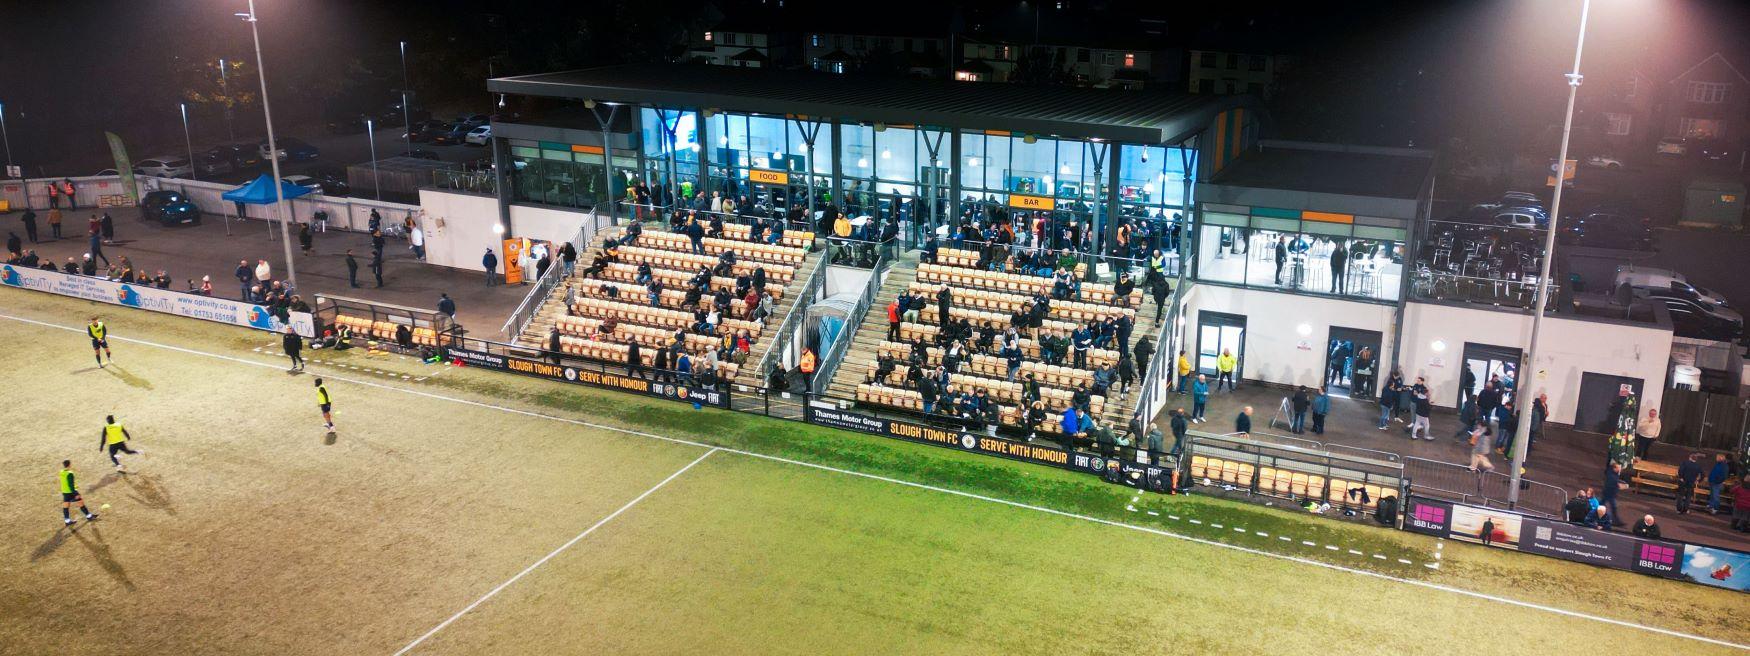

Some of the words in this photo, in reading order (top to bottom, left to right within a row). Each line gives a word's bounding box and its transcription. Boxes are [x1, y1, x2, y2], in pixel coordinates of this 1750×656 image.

[1024, 198, 1039, 206] BAR
[177, 297, 237, 311] www.optivity.co.uk
[194, 309, 213, 318] 01753
[469, 352, 485, 360] Motor
[485, 355, 502, 364] Group
[508, 359, 533, 372] SLOUGH
[534, 363, 552, 375] TOWN
[553, 367, 562, 377] FC
[579, 371, 600, 384] SERVE
[601, 374, 618, 387] WITH
[619, 377, 648, 392] HONOUR
[690, 390, 706, 400] Jeep
[814, 409, 840, 420] Thames
[841, 414, 861, 424] Motor
[862, 417, 883, 428] Group
[890, 422, 921, 438] SLOUGH
[923, 428, 946, 443] TOWN
[947, 432, 958, 445] FC
[980, 438, 1007, 454] SERVE
[1009, 443, 1031, 458] WITH
[1031, 447, 1068, 464] HONOUR
[1075, 455, 1089, 468] FIAT
[1413, 519, 1426, 528] IBB
[1427, 522, 1443, 530] Law
[1639, 559, 1653, 568] IBB
[1654, 562, 1673, 571] Law
